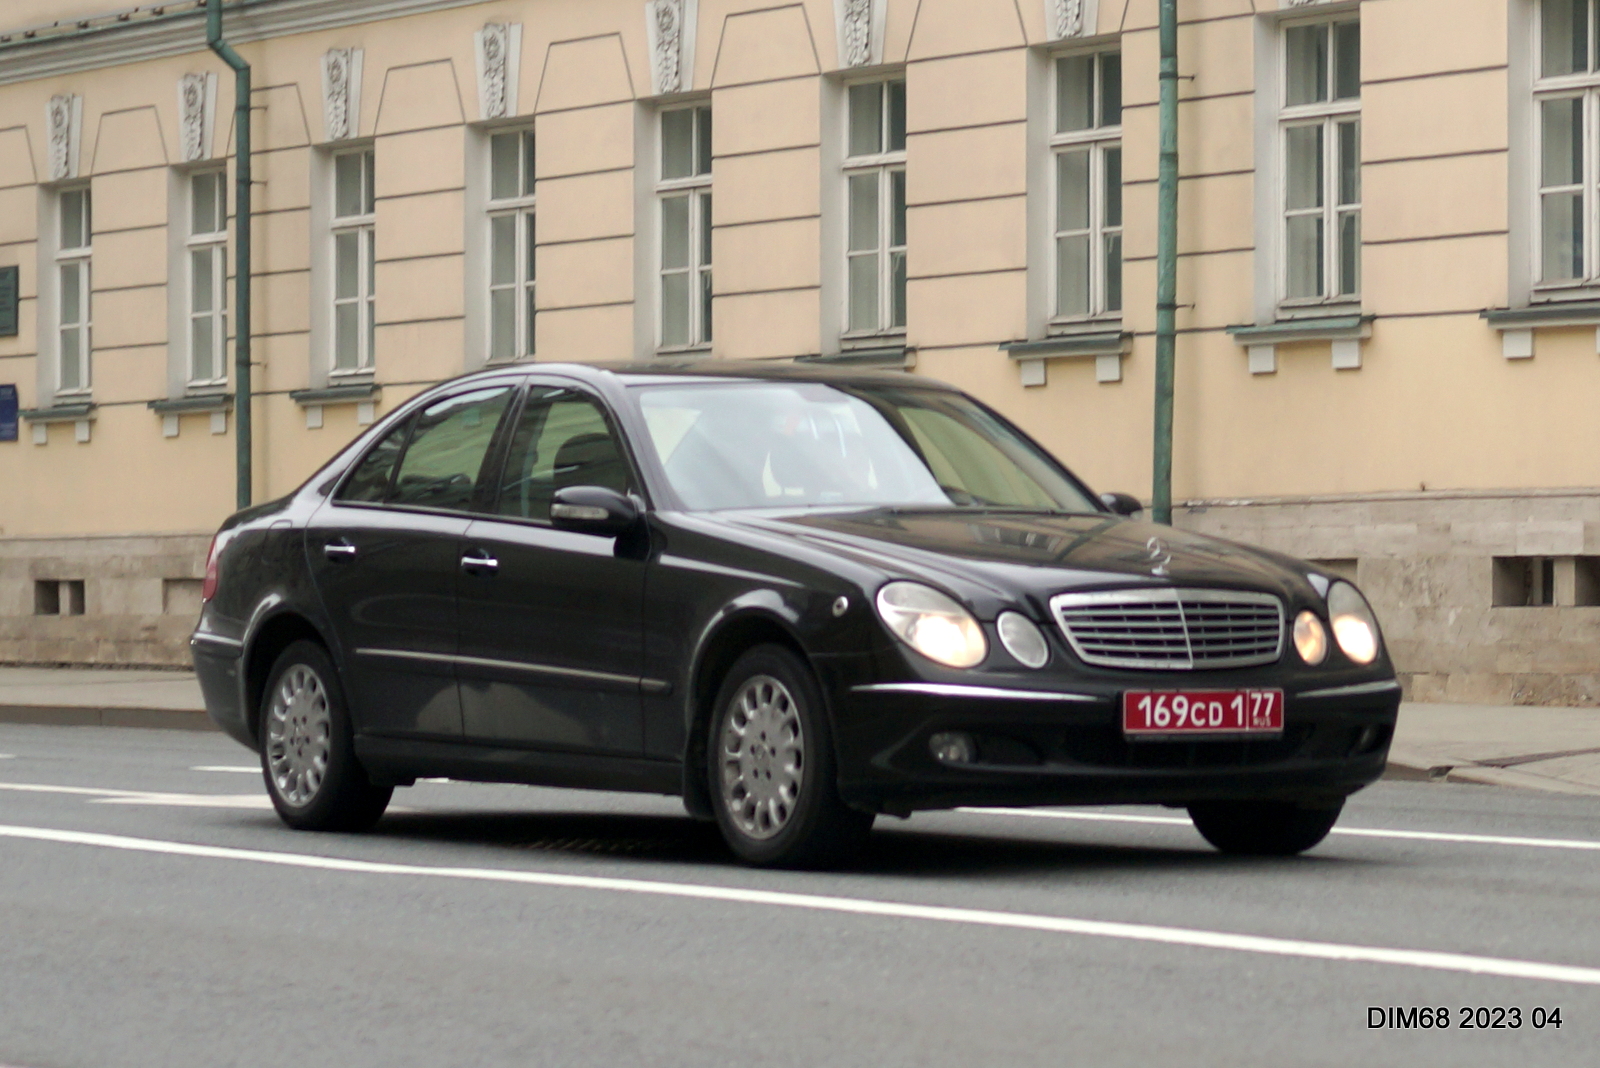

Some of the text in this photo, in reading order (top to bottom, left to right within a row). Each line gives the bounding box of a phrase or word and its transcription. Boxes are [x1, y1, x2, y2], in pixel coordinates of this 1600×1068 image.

[1138, 692, 1274, 727] 169CD 1 77
[1253, 716, 1271, 727] RUS
